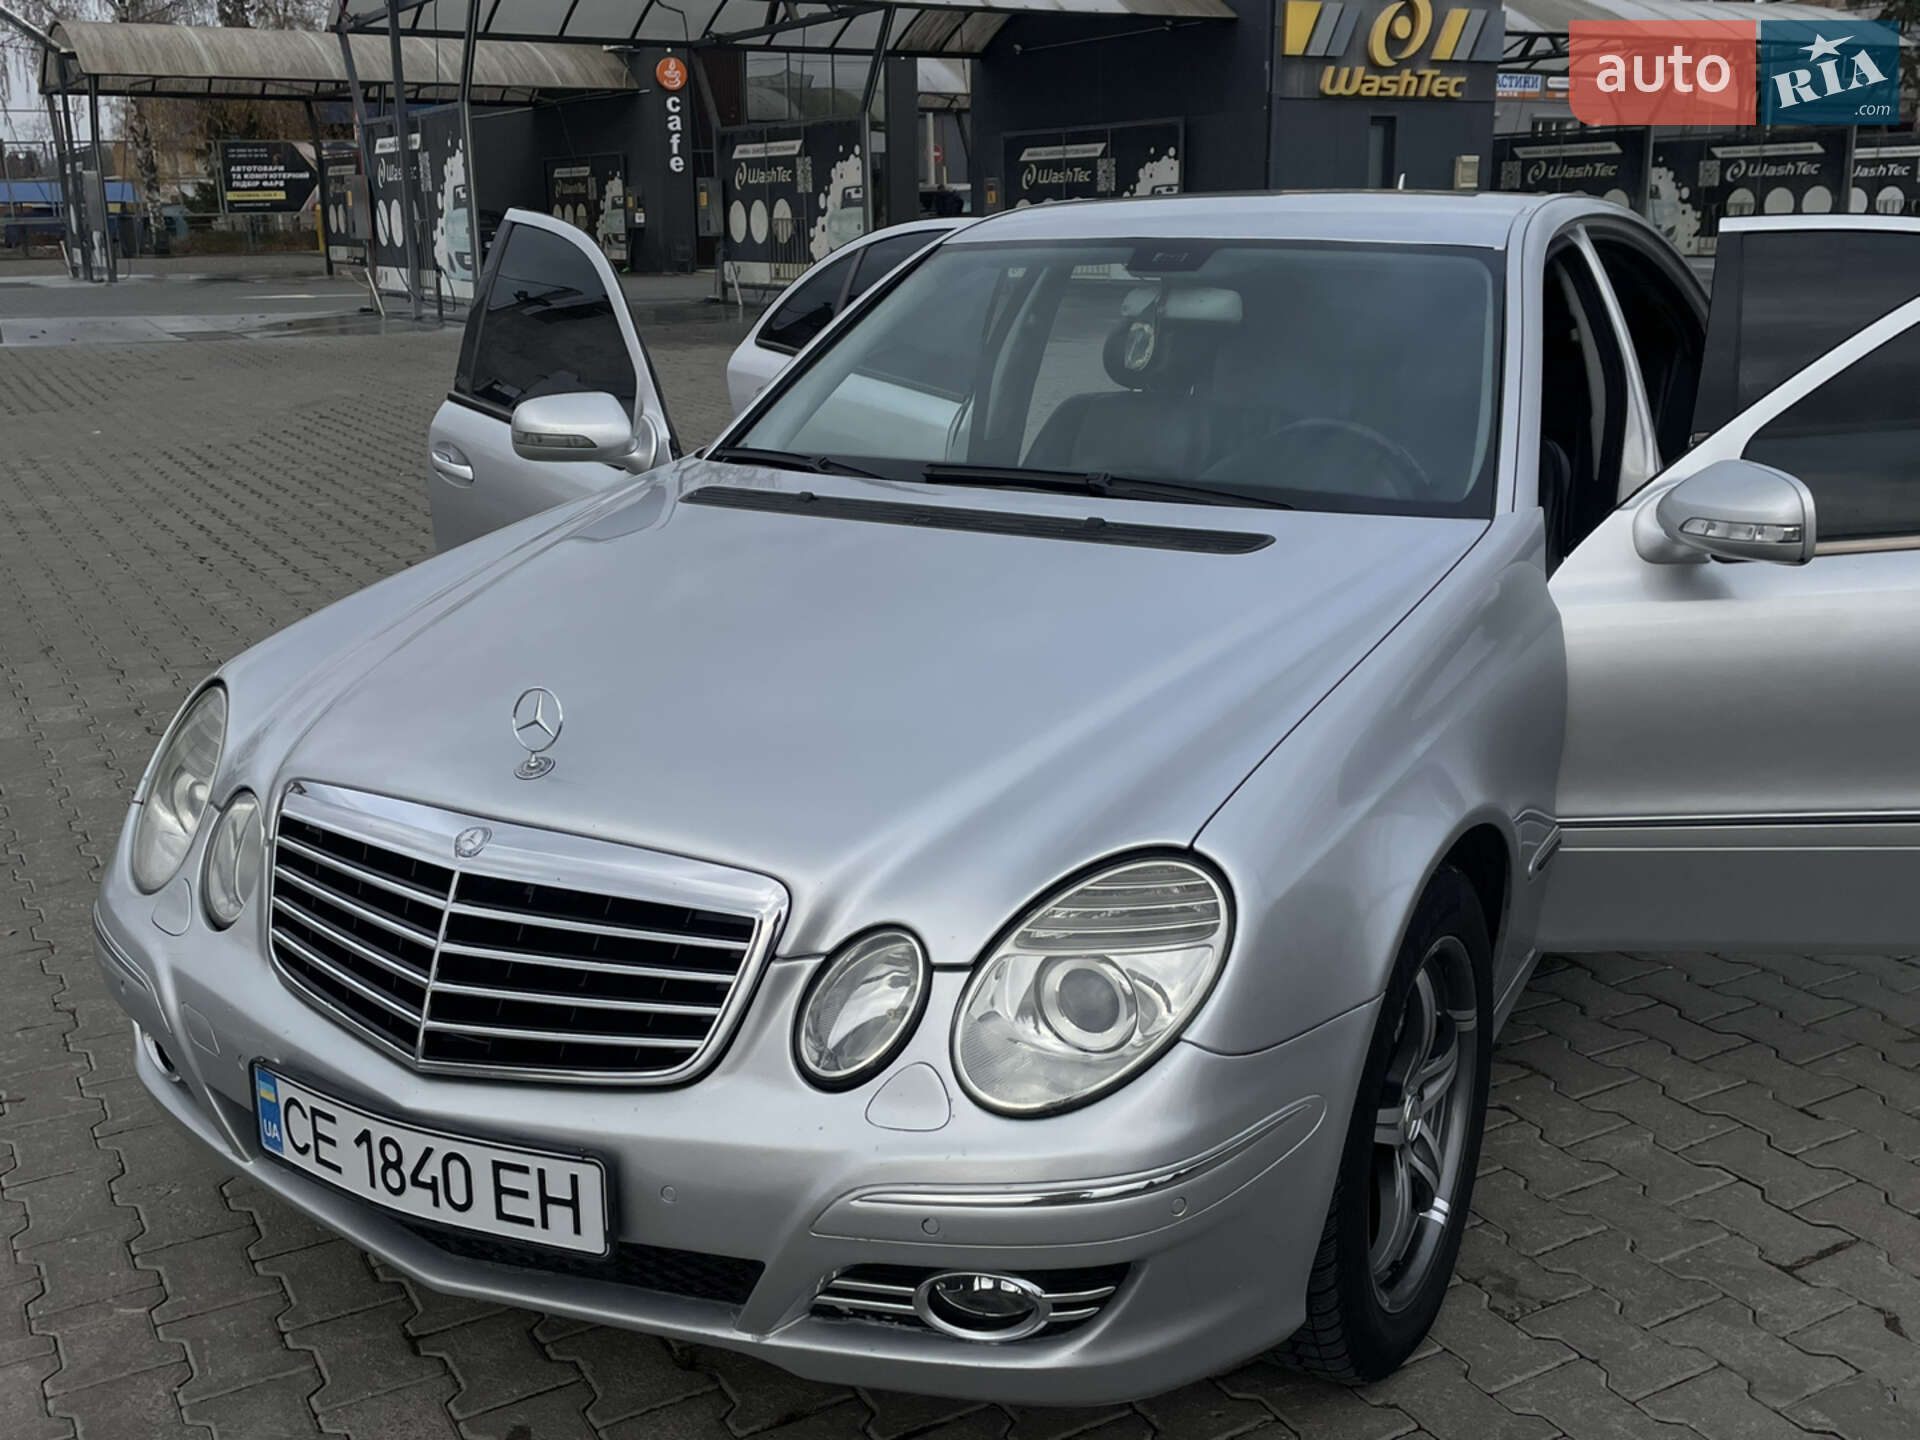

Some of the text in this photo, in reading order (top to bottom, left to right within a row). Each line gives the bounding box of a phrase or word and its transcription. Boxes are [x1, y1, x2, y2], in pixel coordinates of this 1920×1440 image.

[1320, 65, 1467, 98] WashTec
[666, 96, 685, 173] cafe
[386, 163, 418, 181] Wasec
[747, 166, 793, 184] WashTec
[1037, 167, 1092, 184] WashTec
[1547, 162, 1619, 179] WashTec
[1748, 161, 1821, 177] WashTec
[263, 1118, 281, 1142] UA
[283, 1096, 583, 1236] CE 1840 EH
